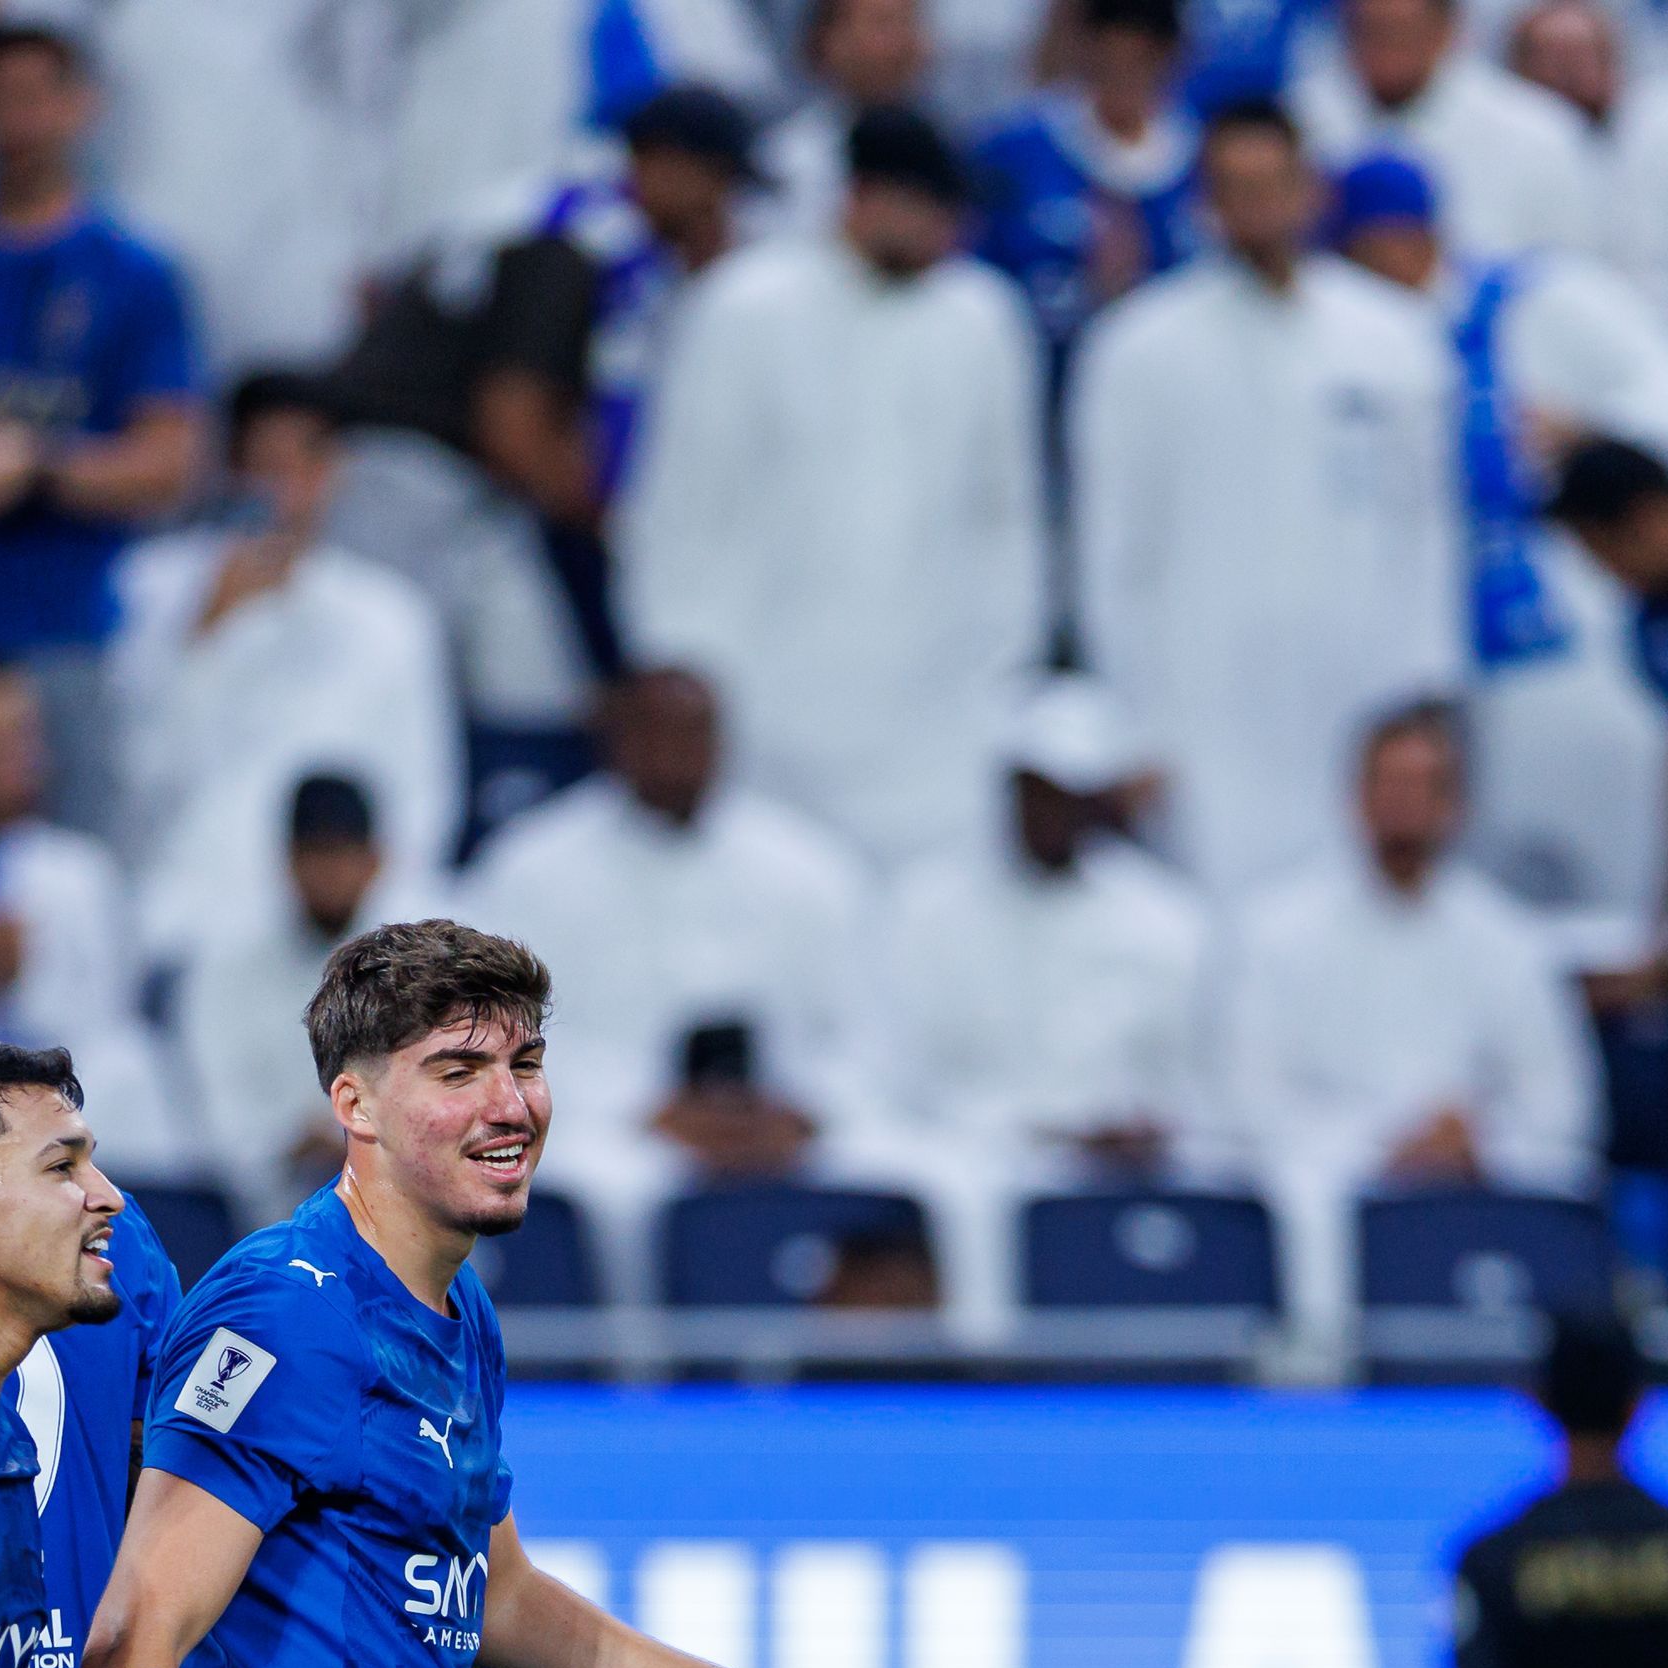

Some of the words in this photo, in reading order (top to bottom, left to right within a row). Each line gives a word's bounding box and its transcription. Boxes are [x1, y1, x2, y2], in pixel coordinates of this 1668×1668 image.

[194, 1385, 230, 1408] CHAMPIONS
[196, 1393, 221, 1409] LEAGUE
[195, 1400, 213, 1412] ELITE
